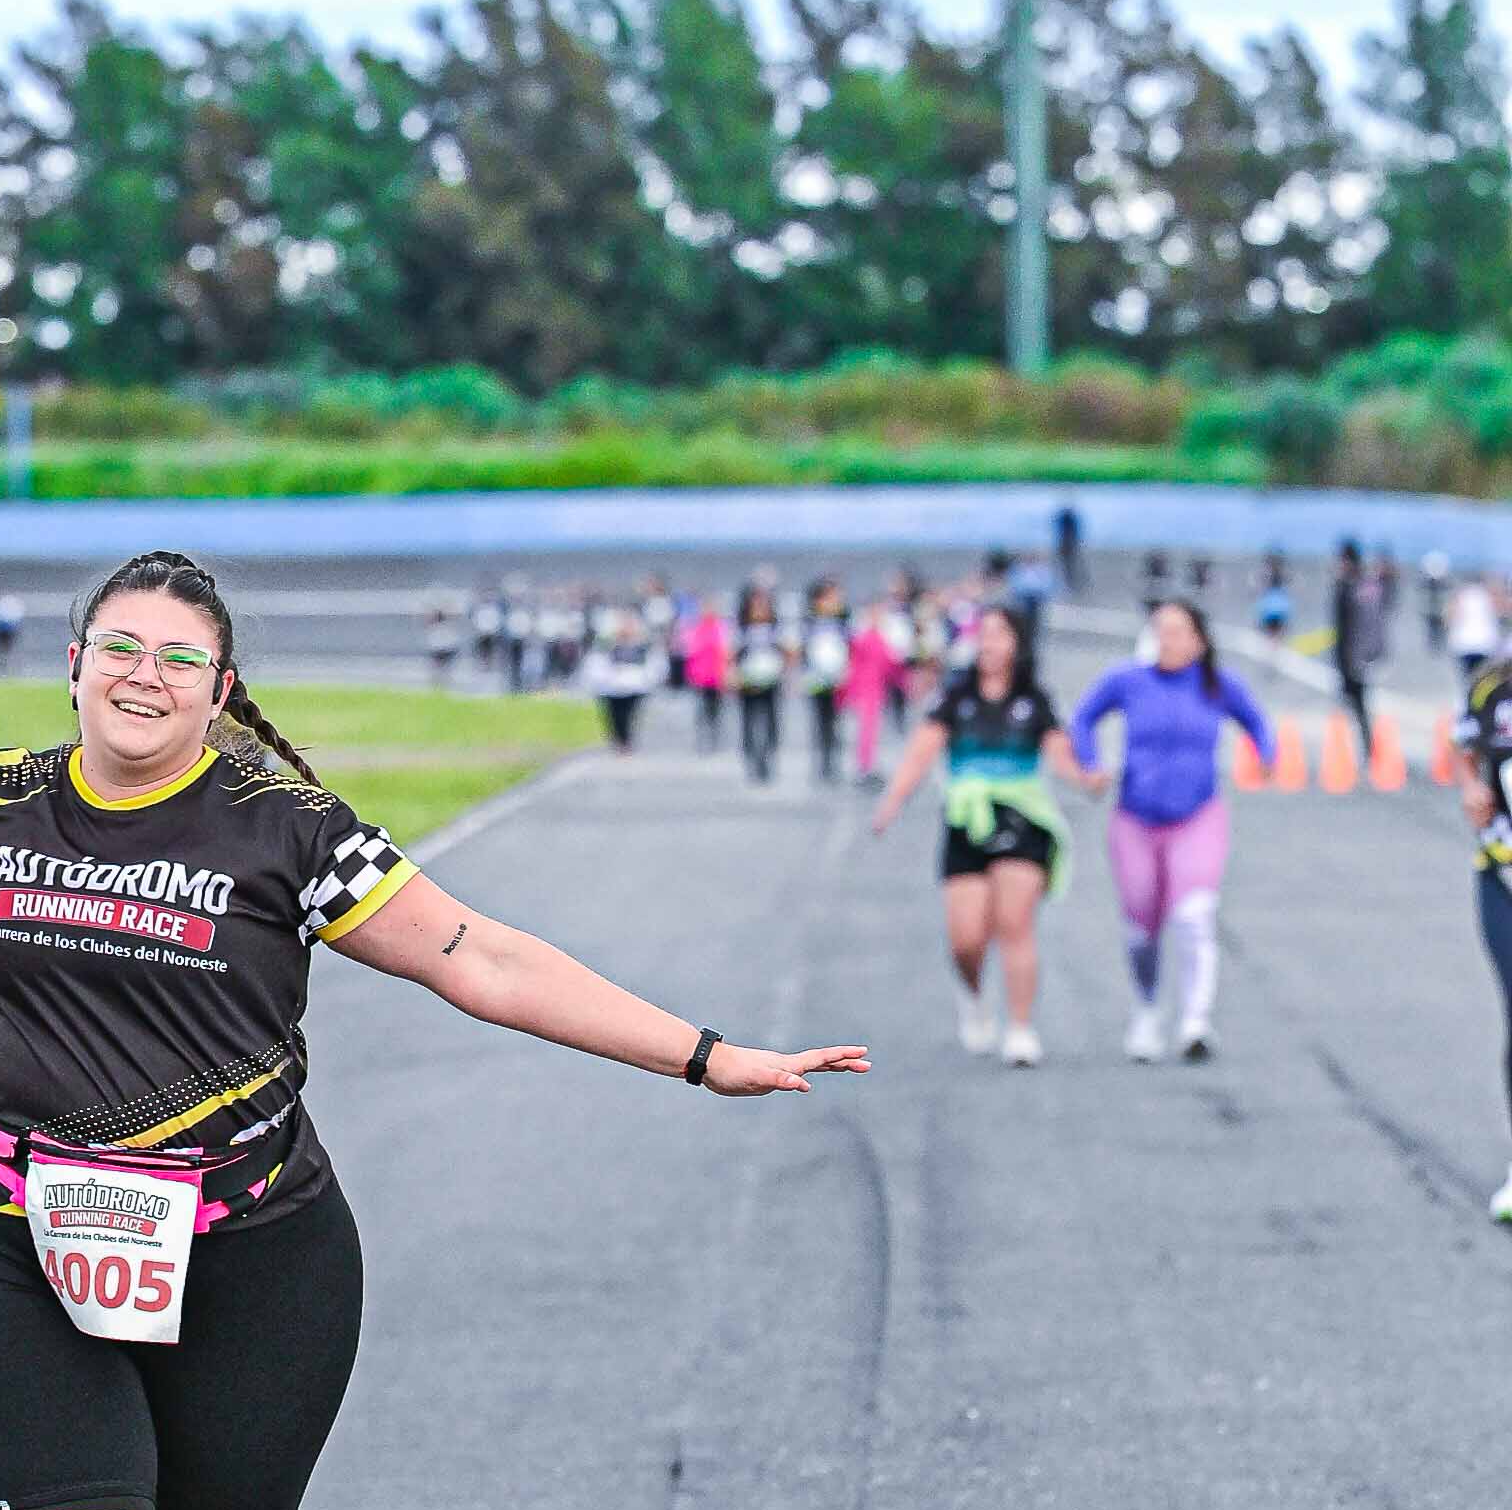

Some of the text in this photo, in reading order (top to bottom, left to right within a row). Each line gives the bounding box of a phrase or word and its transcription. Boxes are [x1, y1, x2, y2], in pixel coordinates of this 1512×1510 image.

[11, 893, 188, 942] RUNNING RACE
[33, 930, 53, 946] de
[55, 933, 77, 950] los
[80, 937, 131, 958] Clubes
[134, 945, 160, 962] del
[162, 949, 228, 973] Noroeste
[43, 1178, 170, 1220] AUTÓDROMO
[60, 1212, 145, 1232] RUNNING RACE
[73, 1232, 81, 1240] de
[119, 1235, 130, 1244] del
